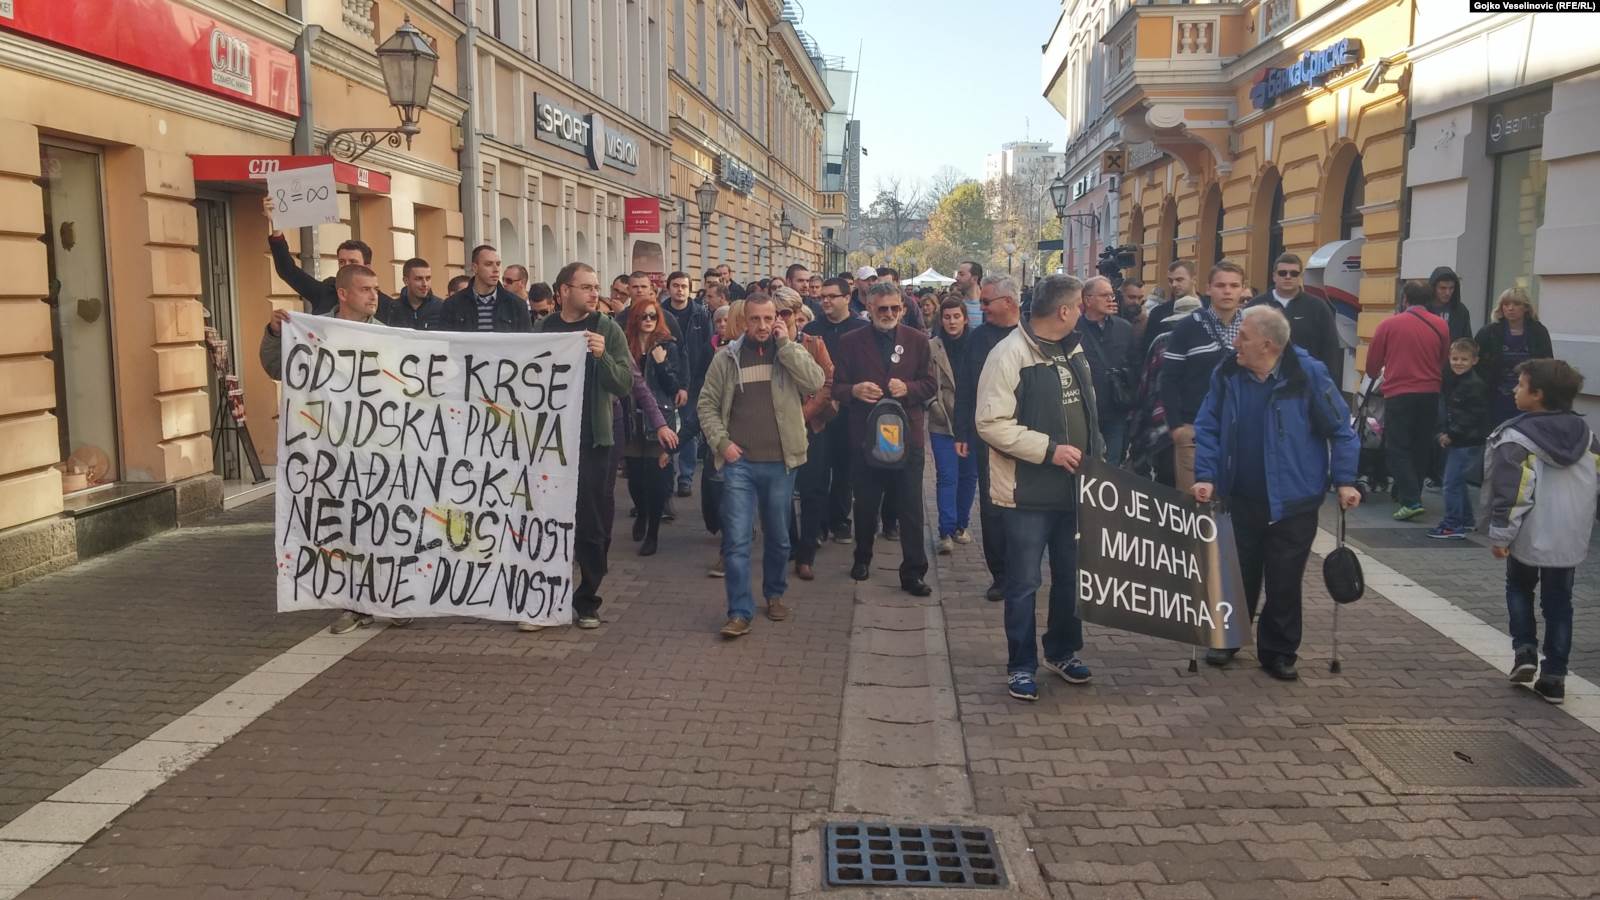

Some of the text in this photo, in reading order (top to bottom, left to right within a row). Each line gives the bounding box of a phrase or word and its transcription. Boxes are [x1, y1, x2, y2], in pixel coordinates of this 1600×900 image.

[211, 29, 251, 80] cm
[249, 159, 280, 174] cm
[543, 103, 639, 168] SPORT VISION
[286, 344, 382, 398] GDJE
[399, 354, 448, 399] SE
[285, 398, 568, 466] LJUDSKA PRAVA
[286, 450, 534, 511] GRAĐANSKA
[1080, 474, 1218, 542] КО ЈЕ УБИО
[283, 494, 574, 562] NEPOSLUŠNOST
[1101, 527, 1202, 583] МИЛАНА
[294, 545, 419, 608] POSTAJE
